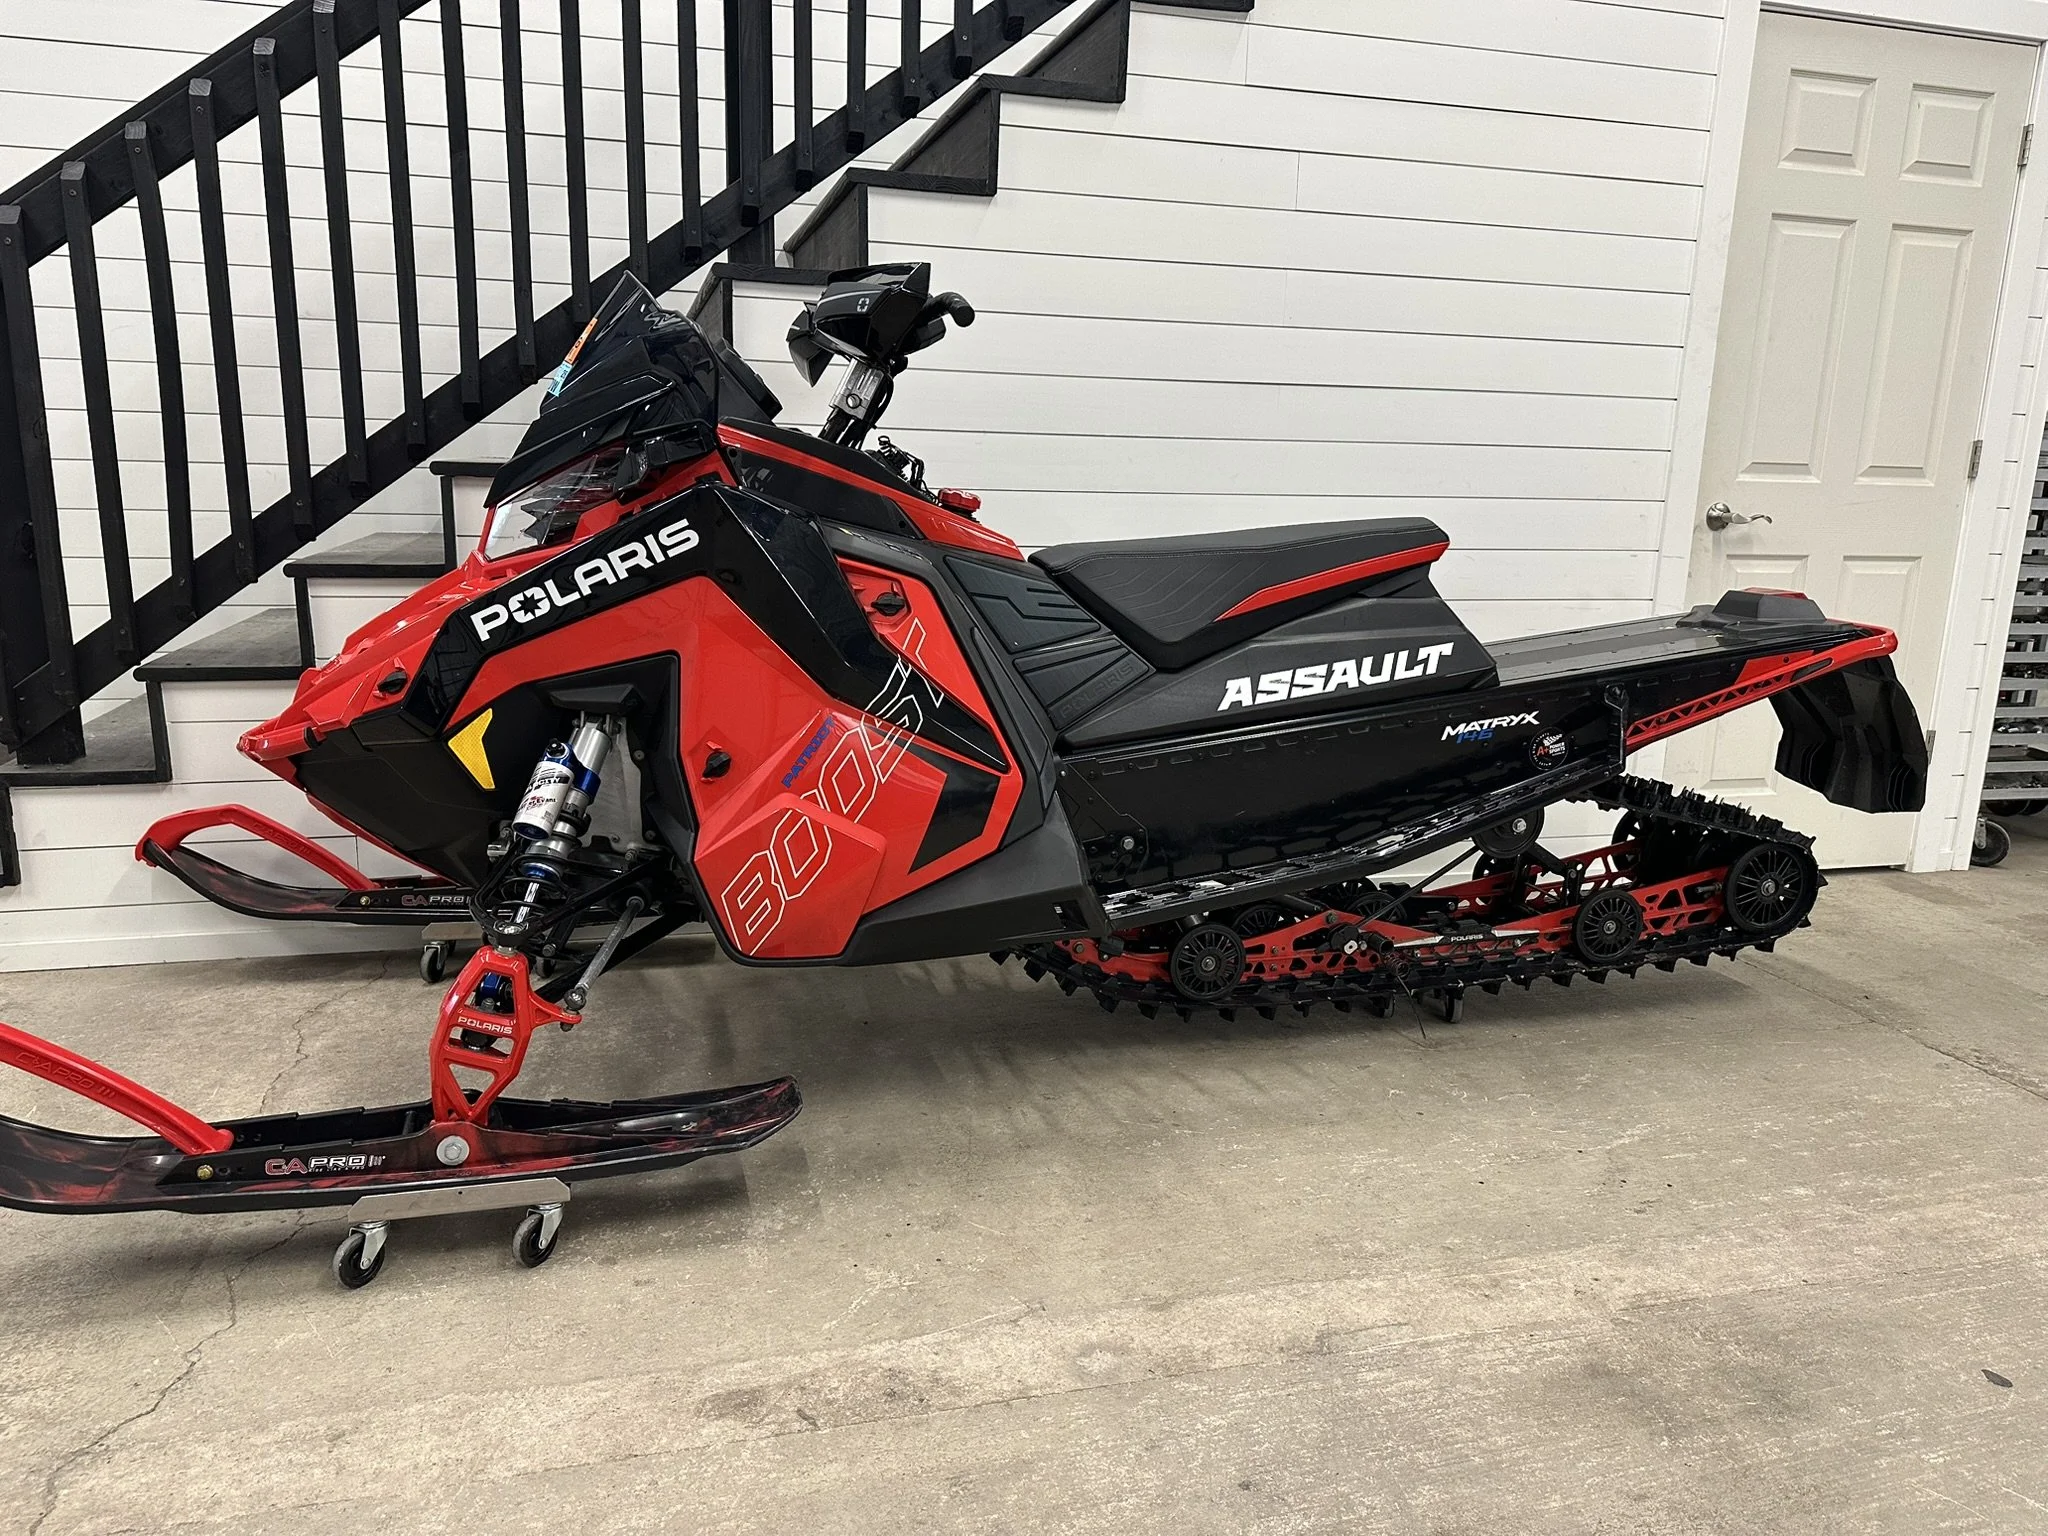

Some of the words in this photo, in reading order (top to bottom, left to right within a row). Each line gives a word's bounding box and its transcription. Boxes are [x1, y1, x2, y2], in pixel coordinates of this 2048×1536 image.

[470, 518, 699, 642] POLARIS
[1217, 642, 1454, 711] ASSAULT
[1441, 711, 1540, 740] MATRYX
[1456, 729, 1494, 744] 146
[781, 714, 835, 788] PATRIOT
[1450, 933, 1484, 943] POLARIS
[457, 1016, 513, 1035] POLARIS
[309, 1155, 366, 1168] PRO
